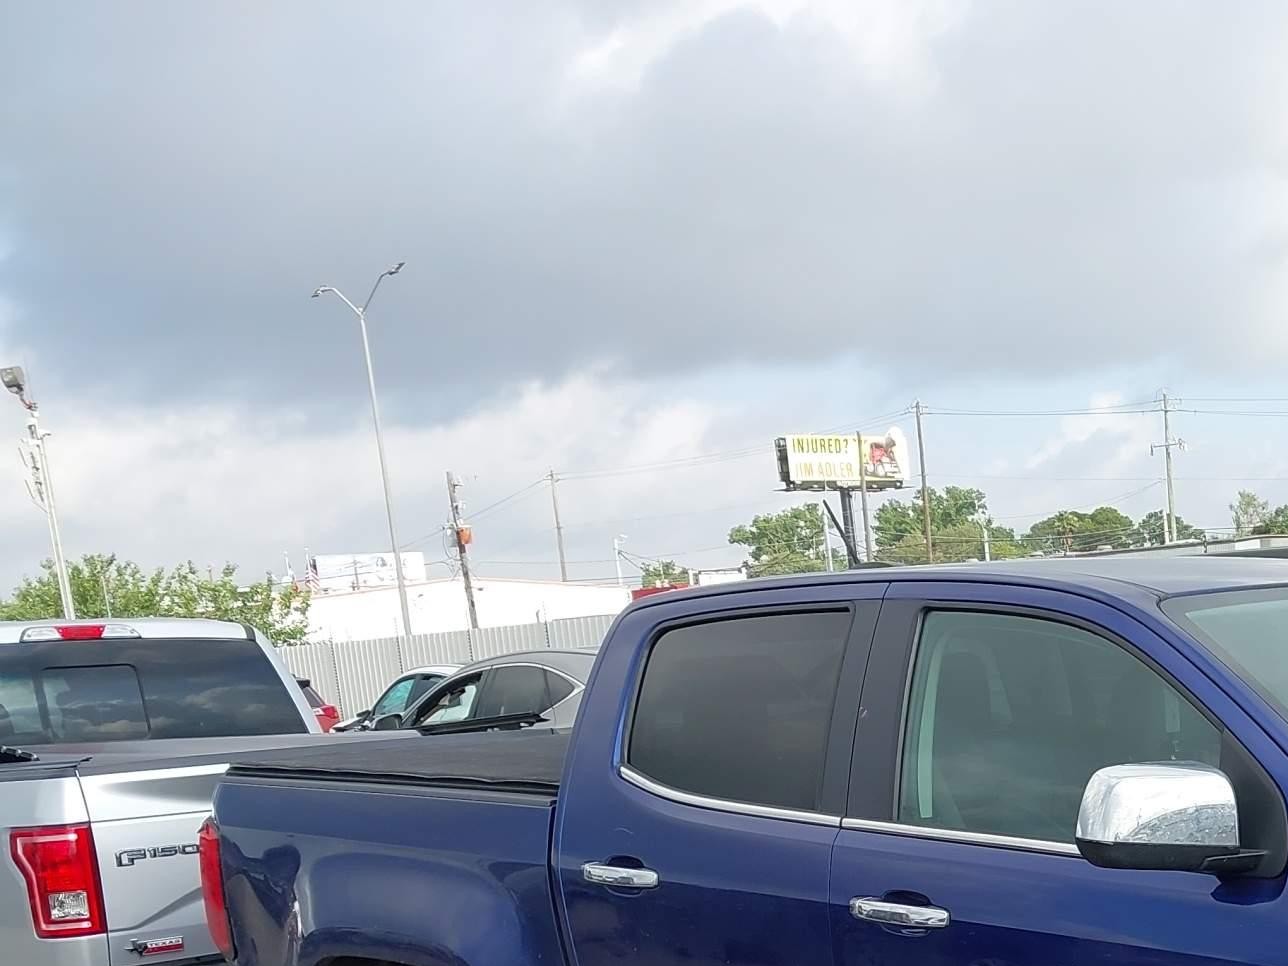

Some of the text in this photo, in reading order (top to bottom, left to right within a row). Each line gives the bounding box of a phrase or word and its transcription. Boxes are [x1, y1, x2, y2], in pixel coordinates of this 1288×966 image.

[792, 438, 849, 454] INJURED?
[795, 462, 854, 478] JIM ADLER
[148, 938, 182, 948] TEXAS
